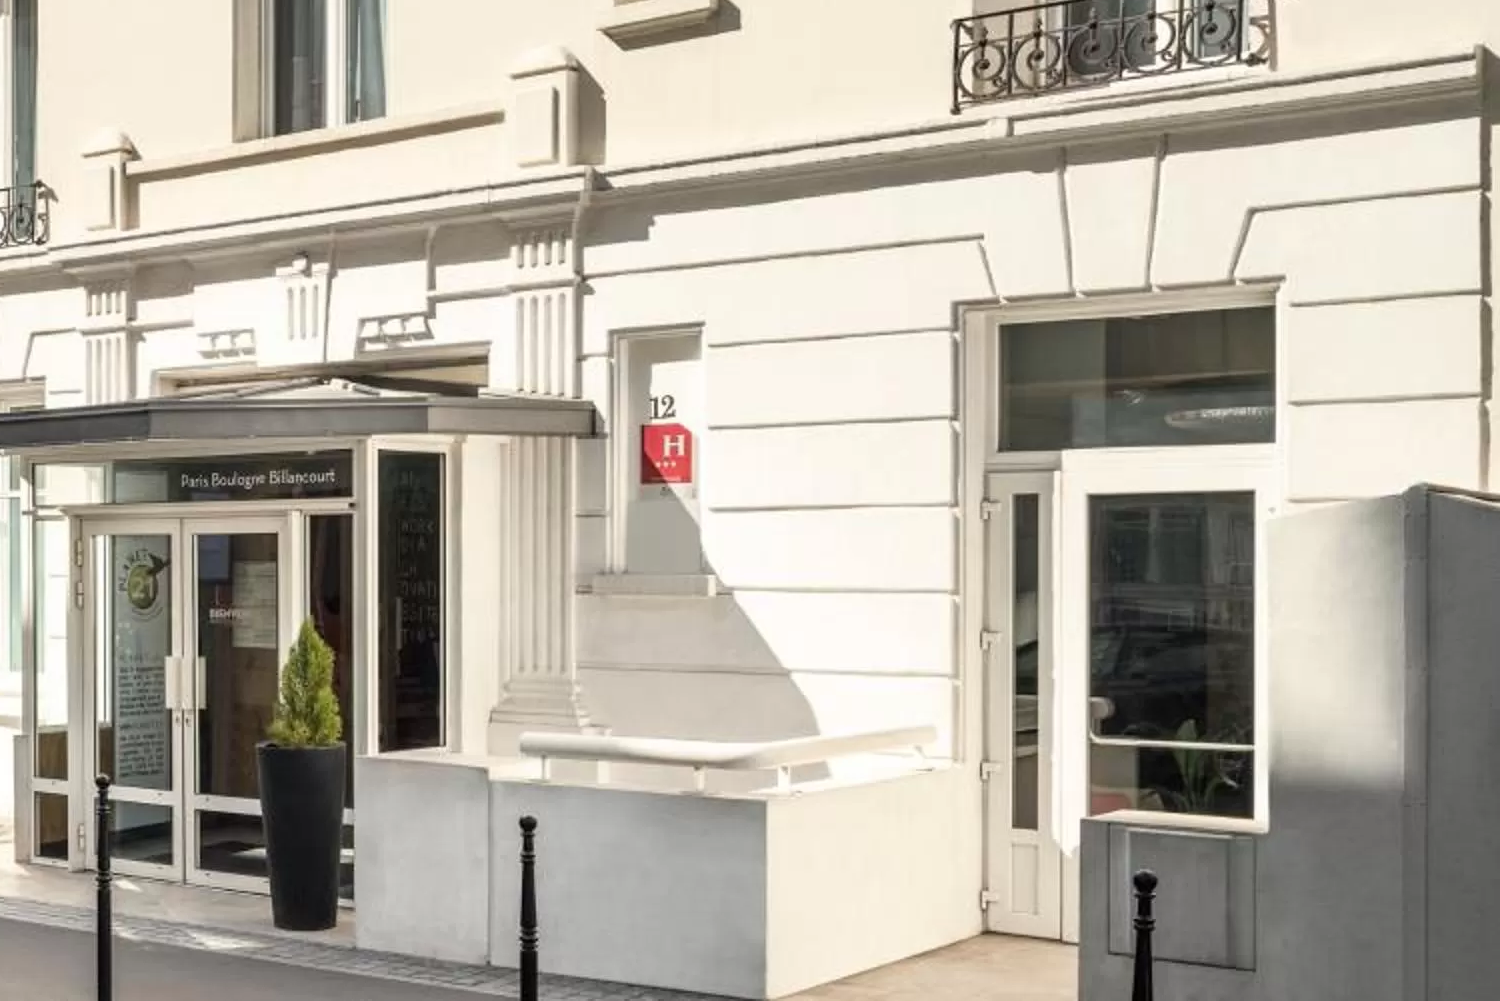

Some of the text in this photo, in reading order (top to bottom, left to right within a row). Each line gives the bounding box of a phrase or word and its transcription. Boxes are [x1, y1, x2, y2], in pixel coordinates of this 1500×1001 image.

[649, 395, 676, 419] 12
[663, 434, 685, 456] H
[180, 467, 336, 490] Paris Boulogne Billancourt
